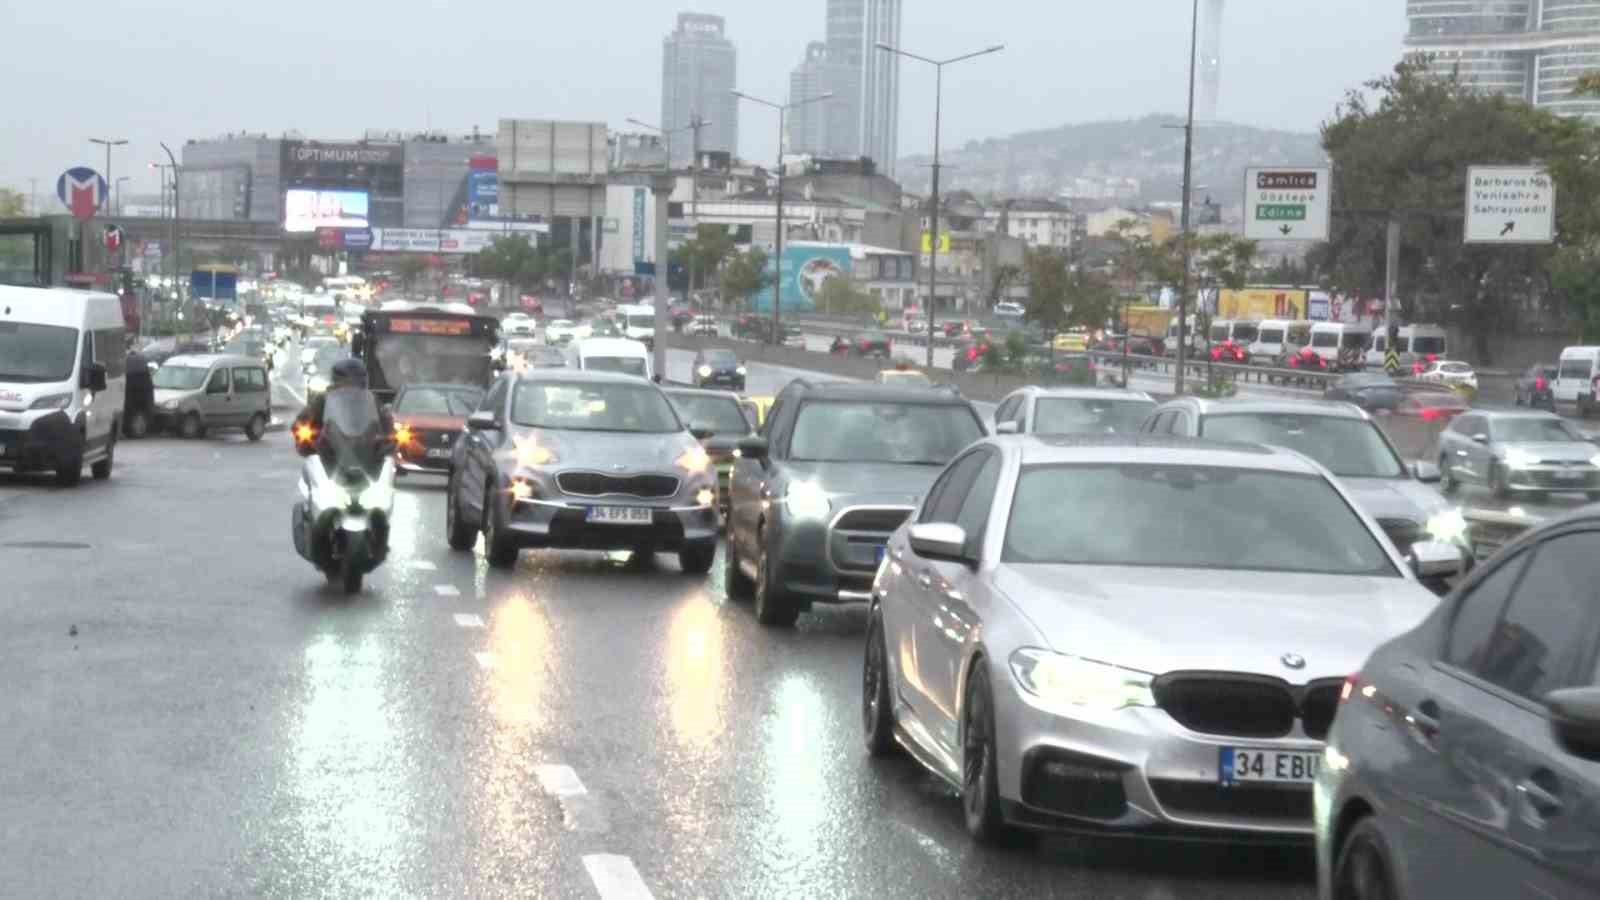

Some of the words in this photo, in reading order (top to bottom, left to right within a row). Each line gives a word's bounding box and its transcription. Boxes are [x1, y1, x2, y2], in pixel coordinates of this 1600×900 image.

[297, 148, 358, 161] OPTIMUM
[1258, 206, 1303, 217] Edirne
[1237, 753, 1265, 778] 34
